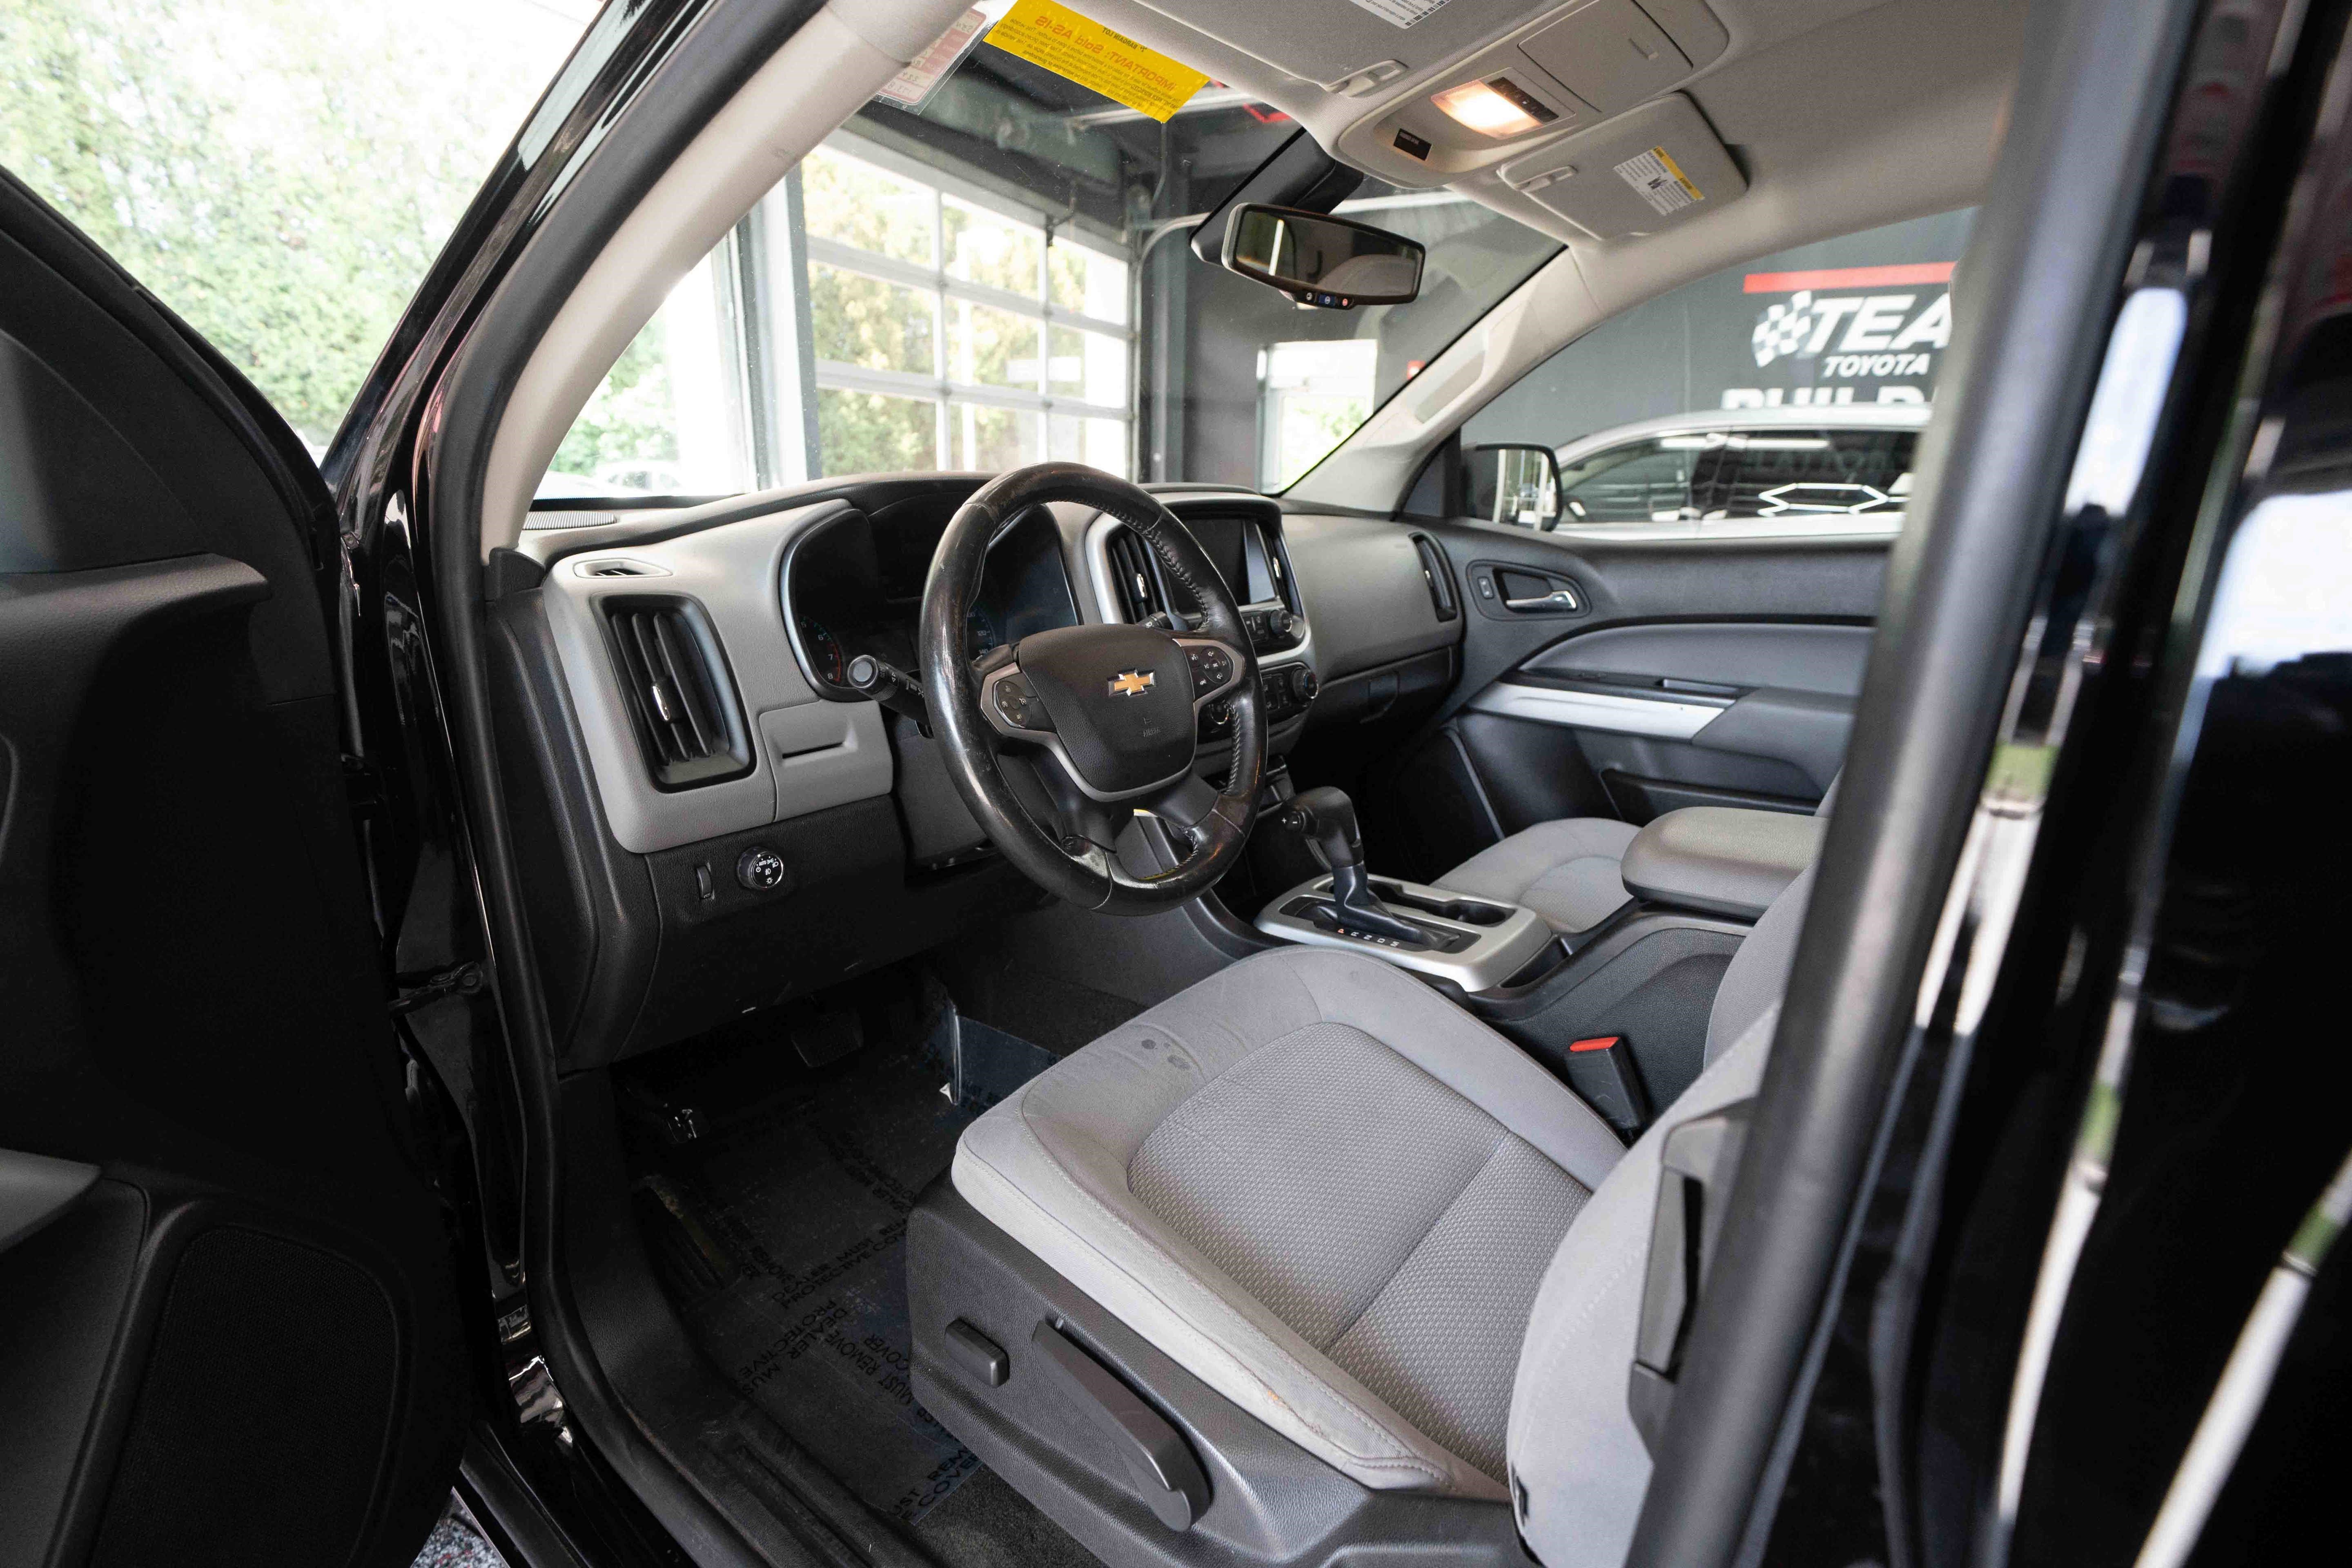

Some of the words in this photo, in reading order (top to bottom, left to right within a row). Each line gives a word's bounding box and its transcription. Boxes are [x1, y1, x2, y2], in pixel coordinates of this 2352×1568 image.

[1805, 293, 1952, 353] TEA
[1823, 353, 1931, 378] TOYOTA
[738, 1298, 837, 1379] PROTECTIVE
[786, 1306, 848, 1359] DEALER
[824, 1330, 880, 1376] REMOVE
[863, 1333, 908, 1371] COVER
[742, 1363, 780, 1396] MUS
[877, 1372, 913, 1405] MUST
[890, 1488, 920, 1516] UST
[927, 1445, 969, 1482] REM
